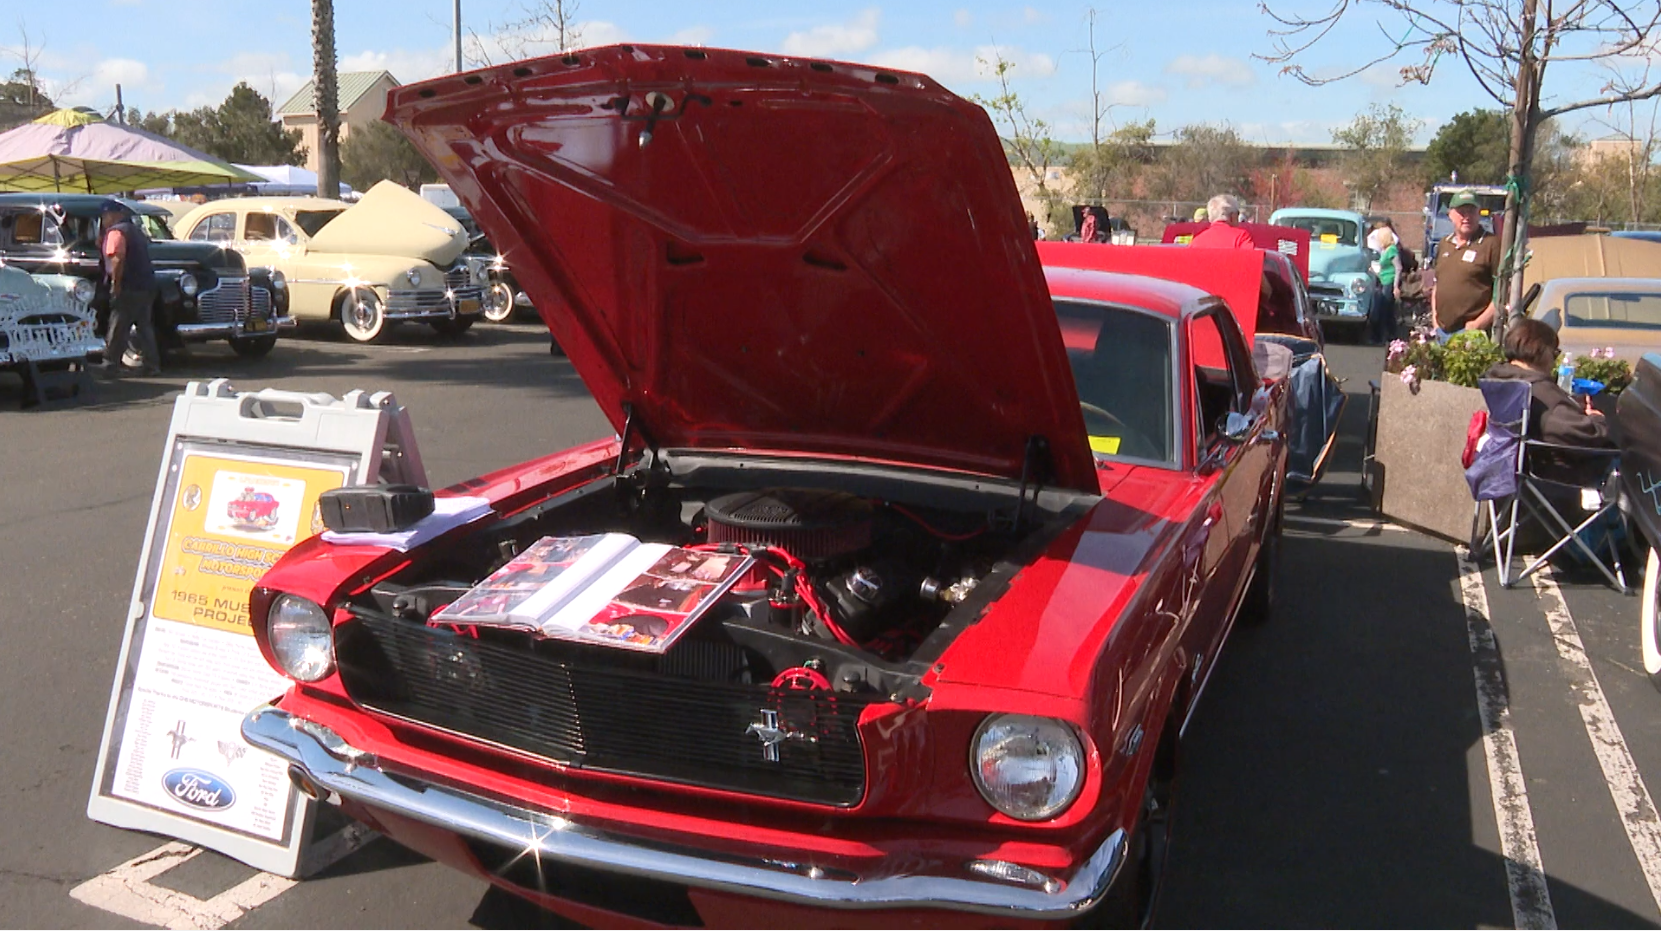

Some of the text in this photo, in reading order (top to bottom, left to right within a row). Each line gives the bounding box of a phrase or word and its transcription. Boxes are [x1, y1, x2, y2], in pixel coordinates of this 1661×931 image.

[236, 546, 263, 562] HIGH
[171, 590, 208, 606] 1965
[174, 773, 222, 807] Ford
